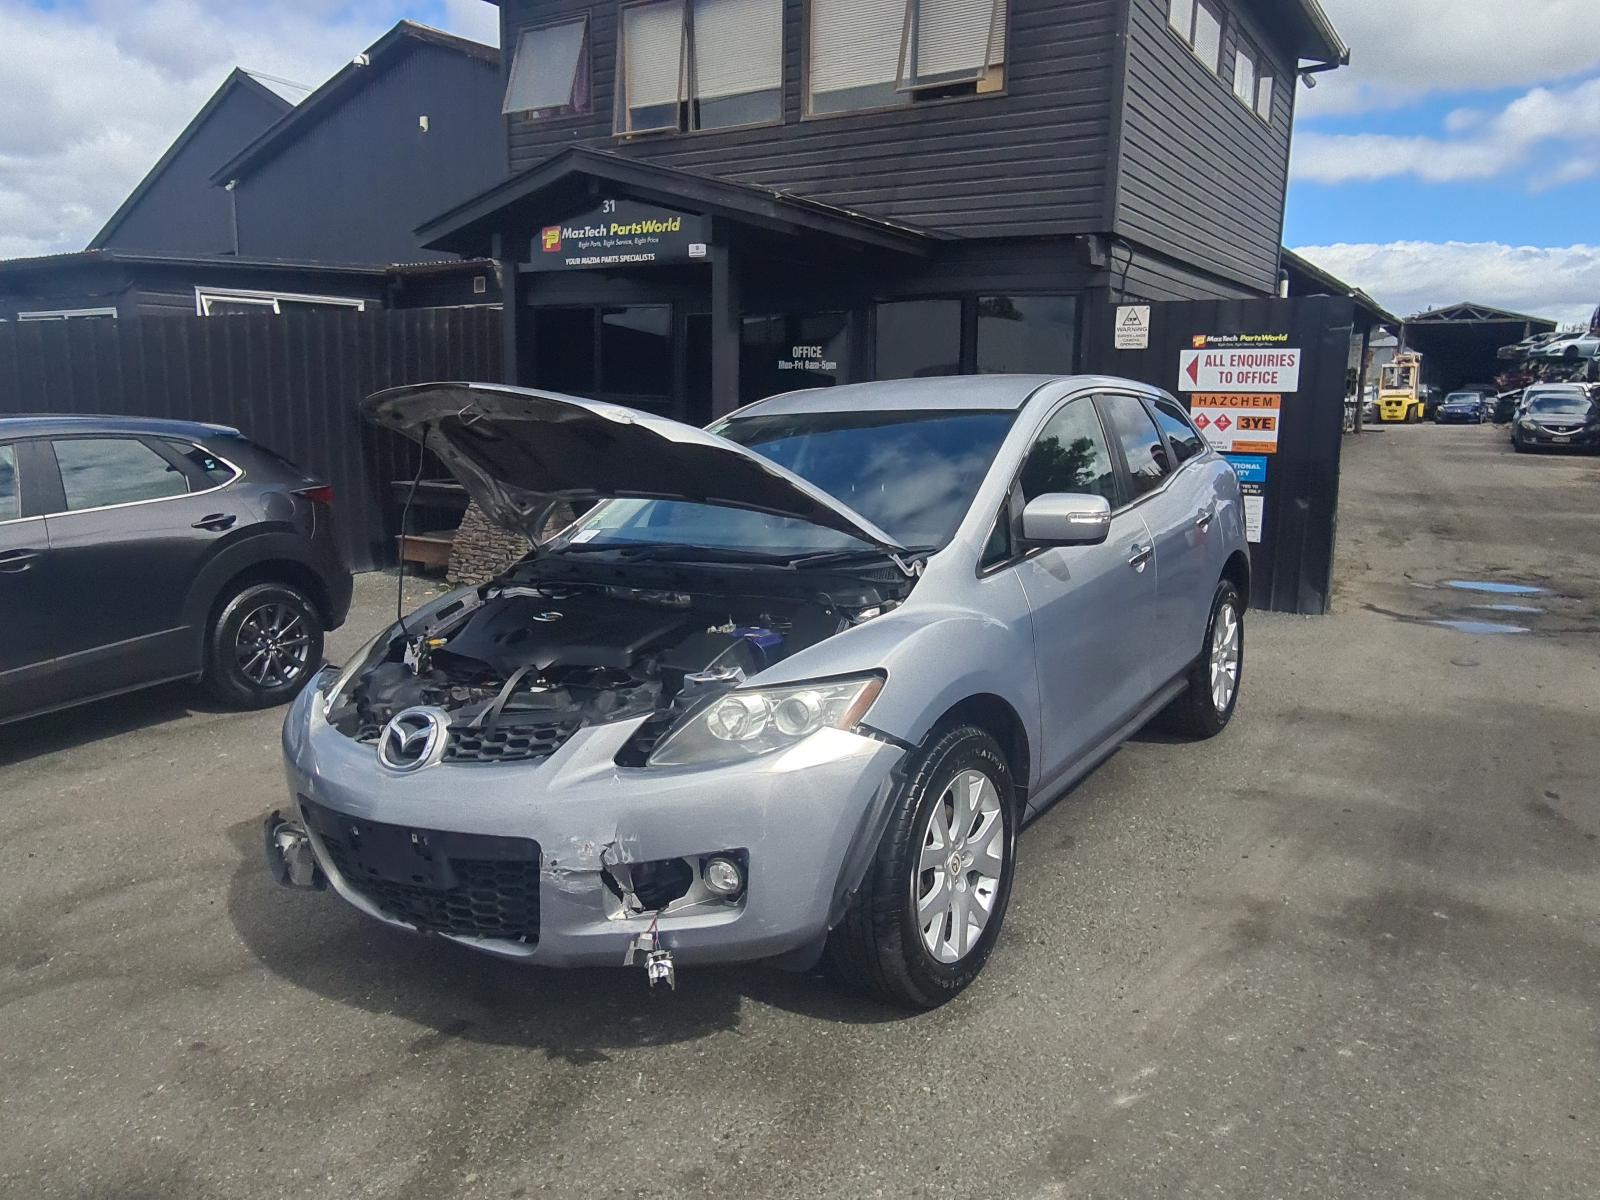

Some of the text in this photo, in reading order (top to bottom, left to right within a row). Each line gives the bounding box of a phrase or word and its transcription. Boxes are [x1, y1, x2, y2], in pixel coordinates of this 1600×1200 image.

[602, 200, 616, 213] 31
[561, 217, 681, 239] MazTech PartsWorld
[600, 255, 619, 263] PARTS
[619, 253, 655, 262] SPECIALISTS
[1206, 334, 1288, 343] MazTech PartsWorld
[792, 346, 823, 358] OFFICE
[778, 360, 804, 370] Mon-Fri
[1204, 354, 1295, 368] ALL ENQUIRIES
[1219, 371, 1279, 384] TO OFFICE
[1199, 396, 1272, 406] HAZCHEM
[1241, 417, 1271, 429] 3YE
